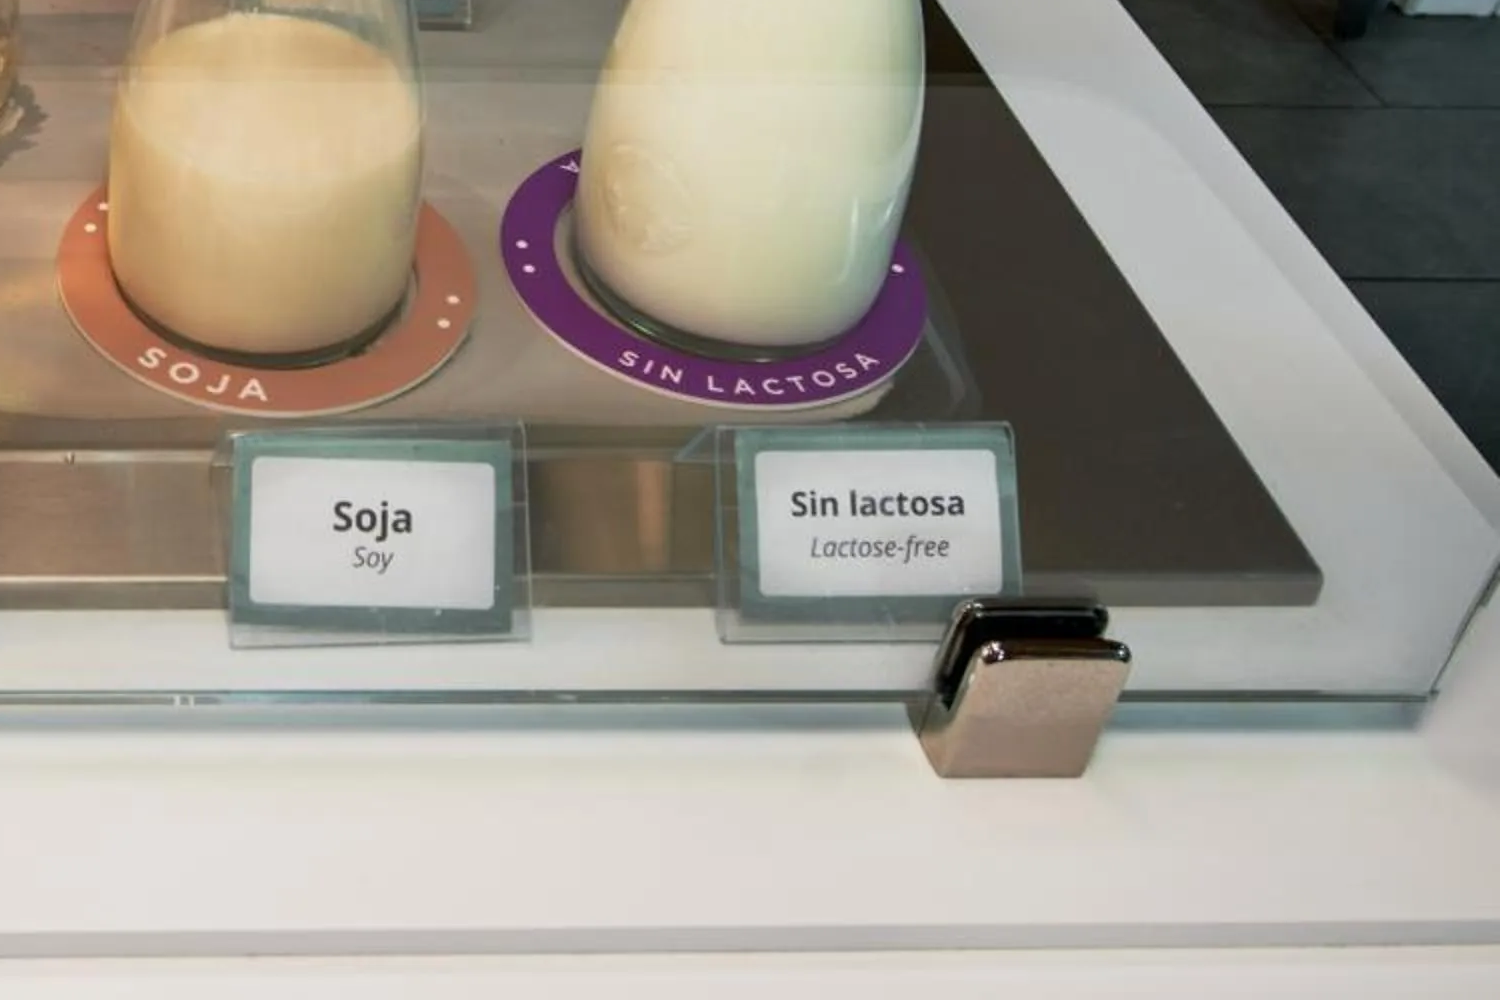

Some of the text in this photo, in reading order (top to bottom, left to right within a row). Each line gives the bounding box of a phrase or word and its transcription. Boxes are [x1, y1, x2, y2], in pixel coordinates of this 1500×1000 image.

[137, 346, 269, 402] SOJA
[618, 350, 880, 397] SIN LACTOSA
[790, 489, 966, 517] Sin lactosa
[332, 500, 413, 543] Soja
[351, 546, 395, 575] Soy
[809, 535, 951, 564] Lactose-free
